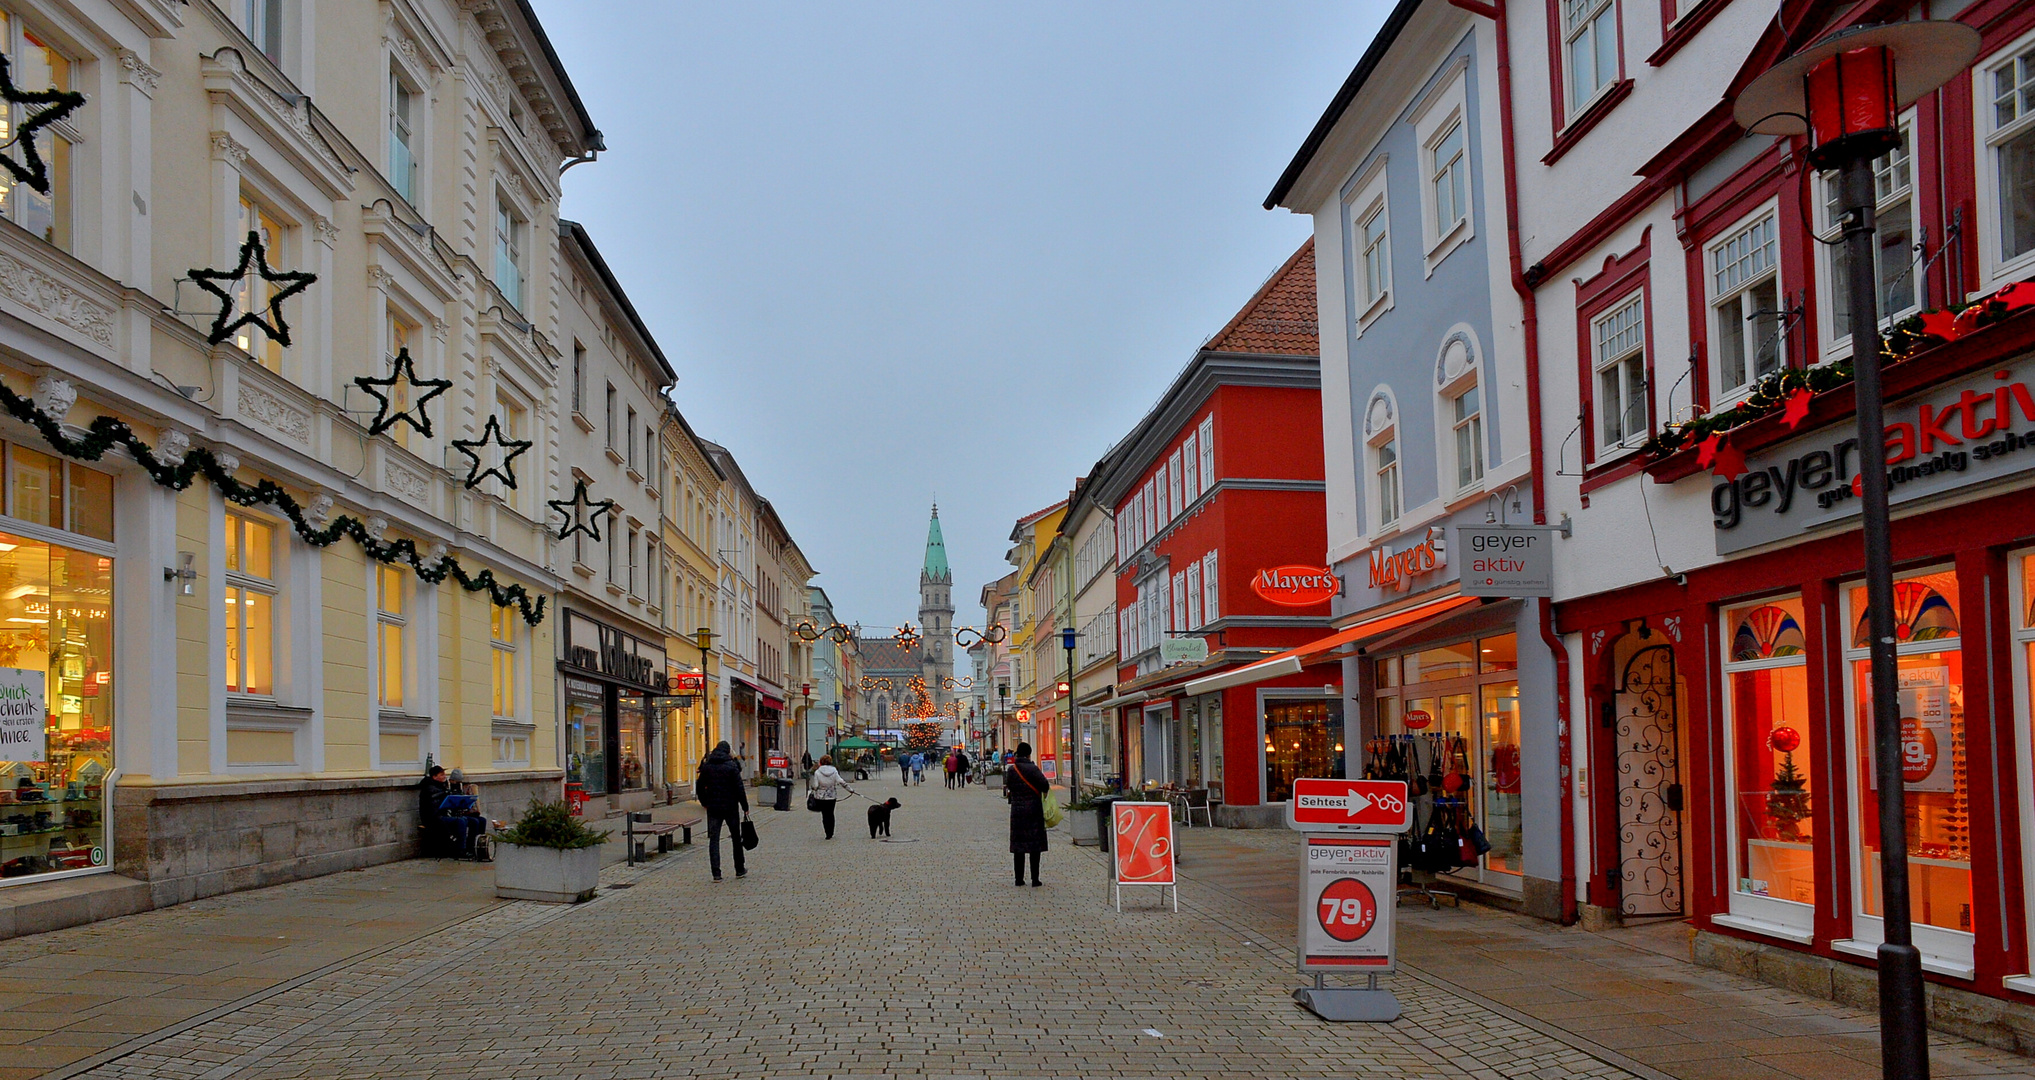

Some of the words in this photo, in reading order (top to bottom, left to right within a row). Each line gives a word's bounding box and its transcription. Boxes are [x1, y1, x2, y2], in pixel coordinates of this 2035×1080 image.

[1711, 437, 1859, 530] geyer
[1817, 484, 1853, 509] gut
[1472, 535, 1537, 553] geyer
[1472, 555, 1525, 572] aktiv
[1908, 668, 1941, 682] aktiv
[1301, 797, 1347, 807] Sehtest
[1310, 848, 1352, 860] geyer
[1353, 847, 1386, 858] aktiv
